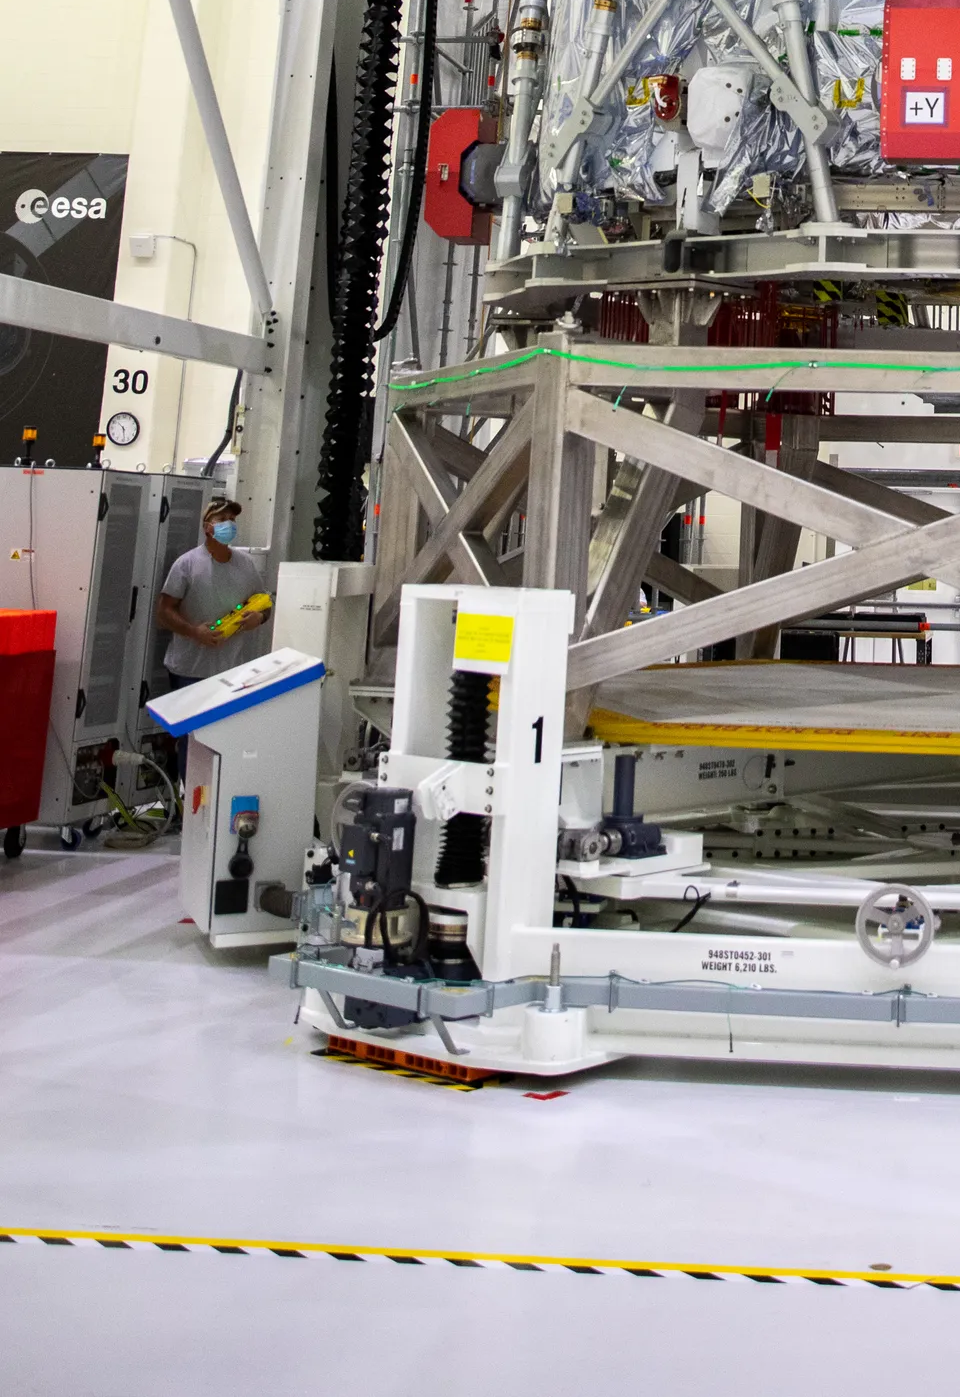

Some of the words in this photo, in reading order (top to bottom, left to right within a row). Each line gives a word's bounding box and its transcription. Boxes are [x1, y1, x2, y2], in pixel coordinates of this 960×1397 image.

[909, 97, 939, 118] +Y
[51, 196, 107, 219] esa
[112, 368, 149, 395] 30
[531, 715, 544, 764] 1
[708, 949, 772, 961] 948ST0452-301
[701, 960, 733, 972] WEIGHT
[734, 963, 757, 974] 6,210
[758, 963, 778, 974] LBS.
